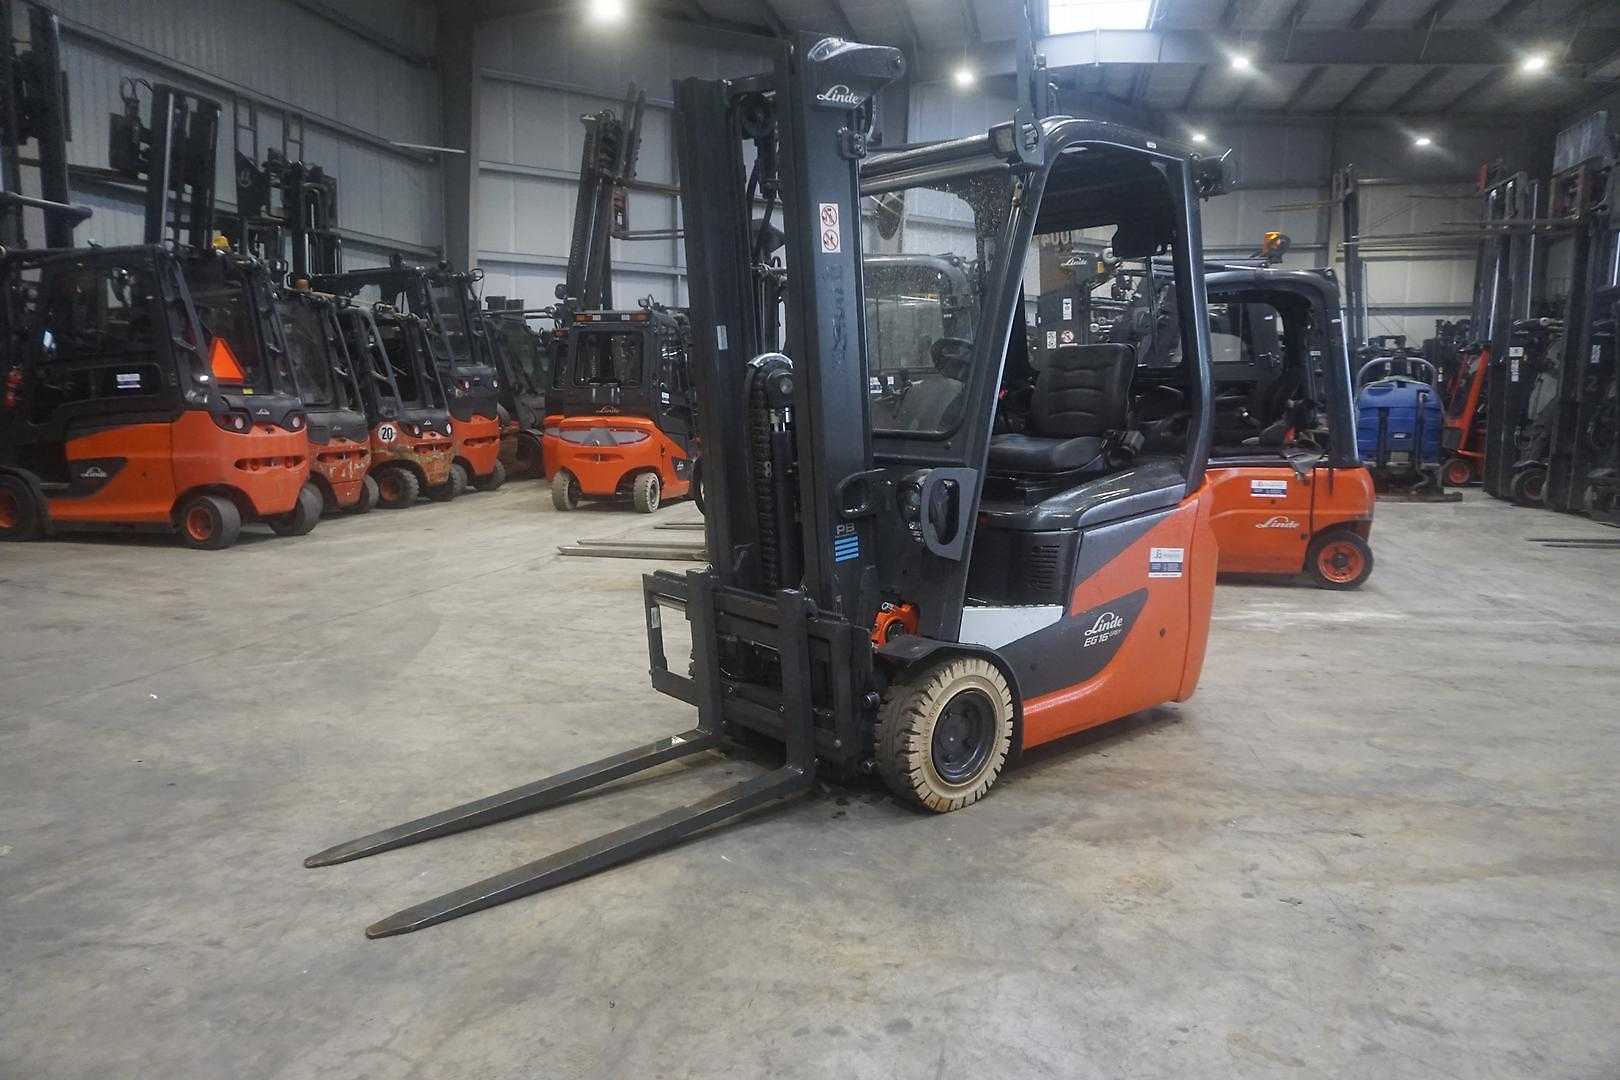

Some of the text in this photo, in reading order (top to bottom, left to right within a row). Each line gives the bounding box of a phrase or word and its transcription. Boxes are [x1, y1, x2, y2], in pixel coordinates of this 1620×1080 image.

[816, 84, 859, 104] Linde
[381, 427, 393, 440] 20
[1255, 515, 1300, 529] Linde
[1084, 611, 1123, 636] Linde
